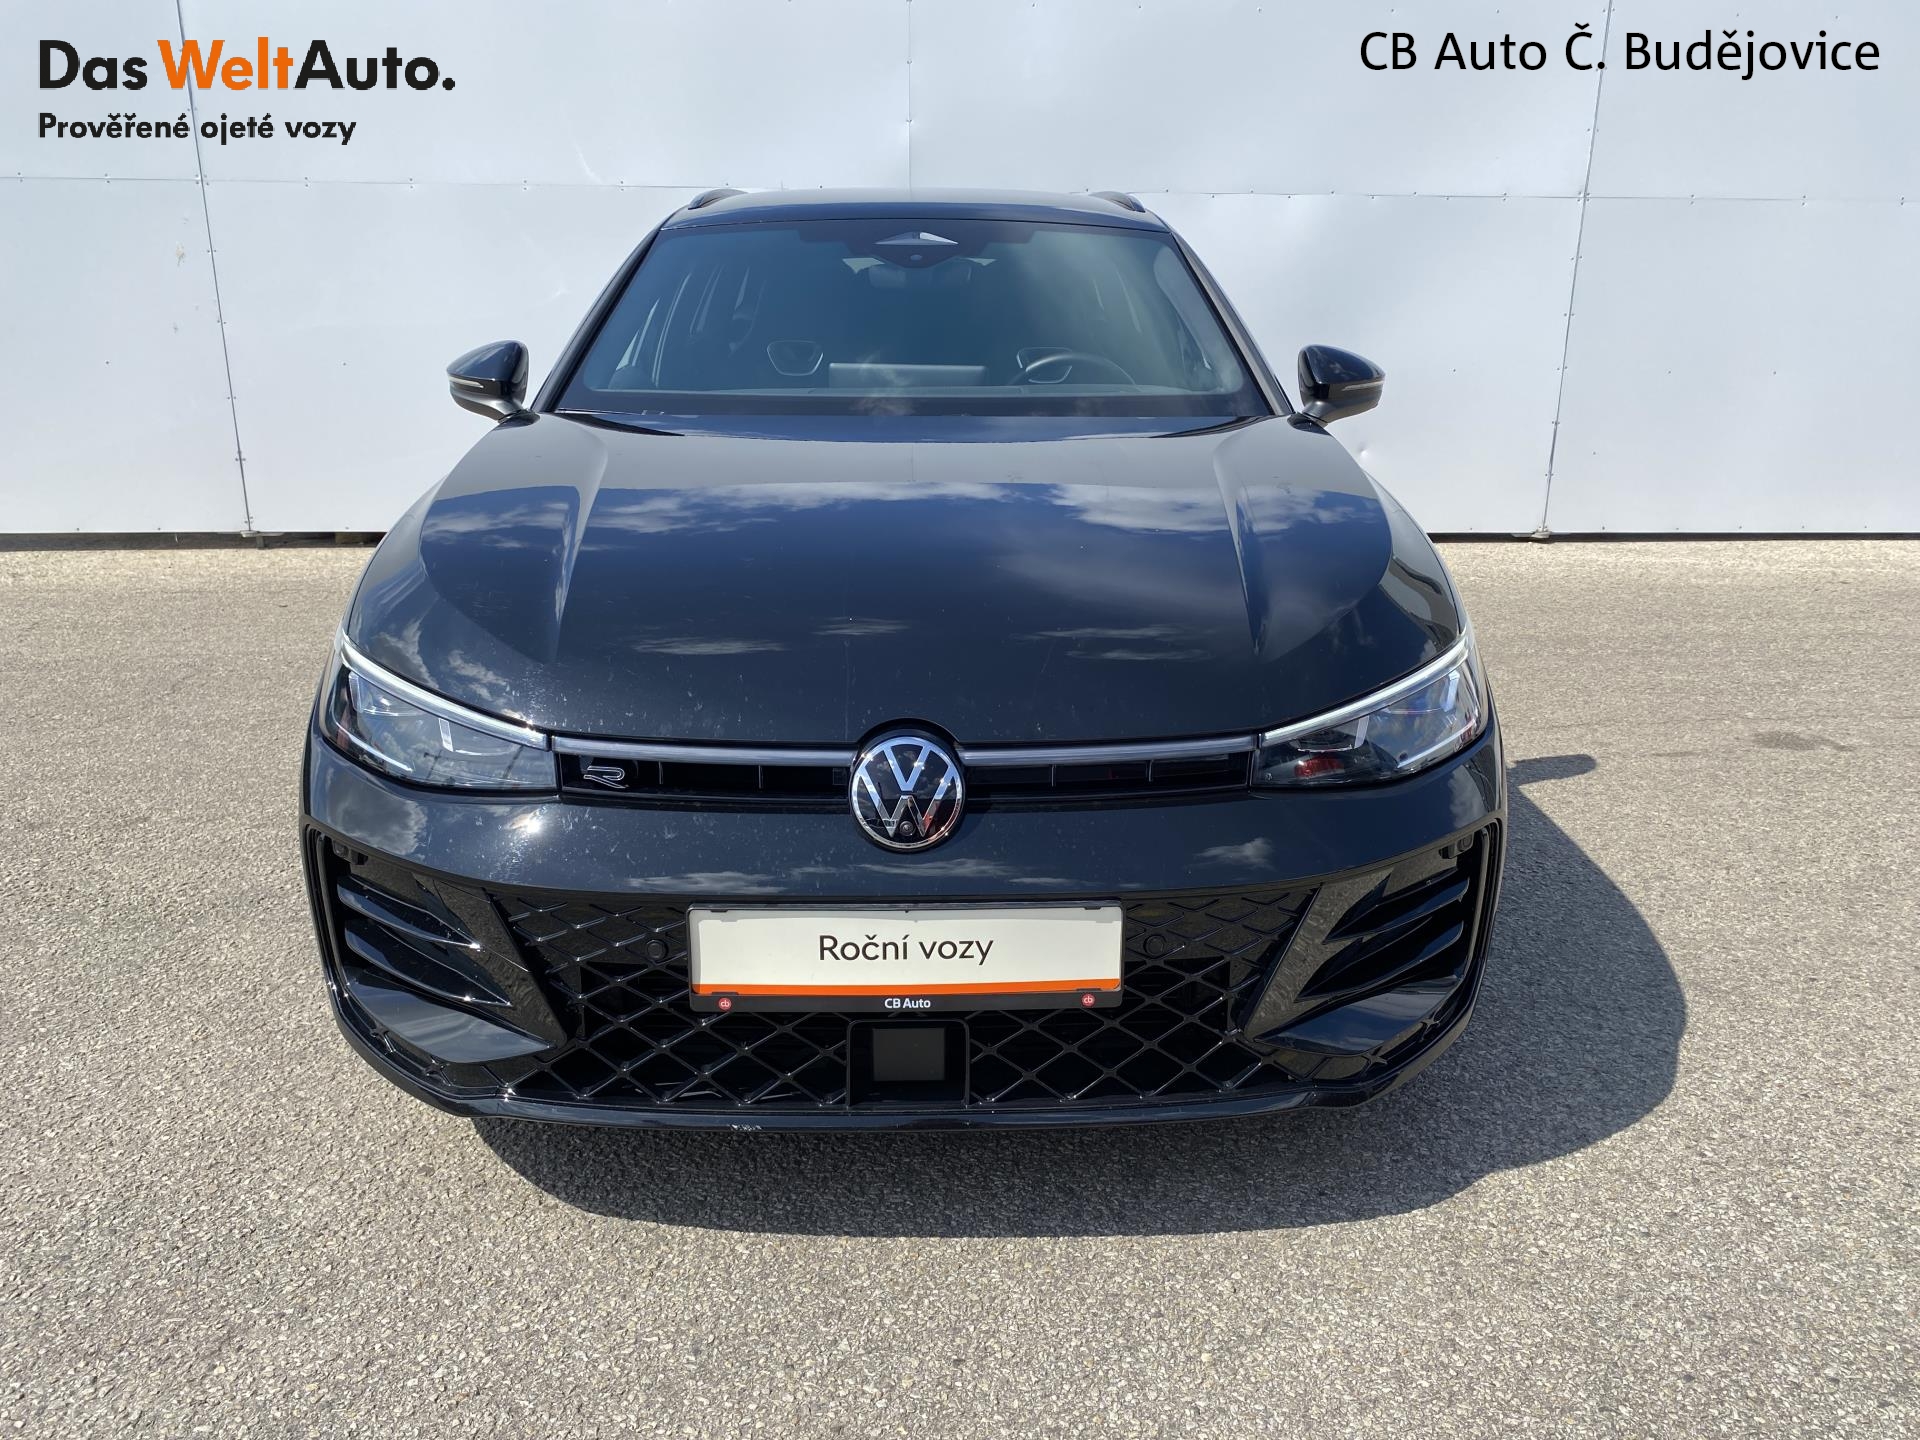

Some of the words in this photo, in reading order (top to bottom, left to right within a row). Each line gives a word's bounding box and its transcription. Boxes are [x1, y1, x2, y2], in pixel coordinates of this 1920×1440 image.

[819, 933, 909, 961] Roční
[919, 938, 994, 965] vozy
[884, 998, 901, 1009] CB
[902, 998, 931, 1009] Auto
